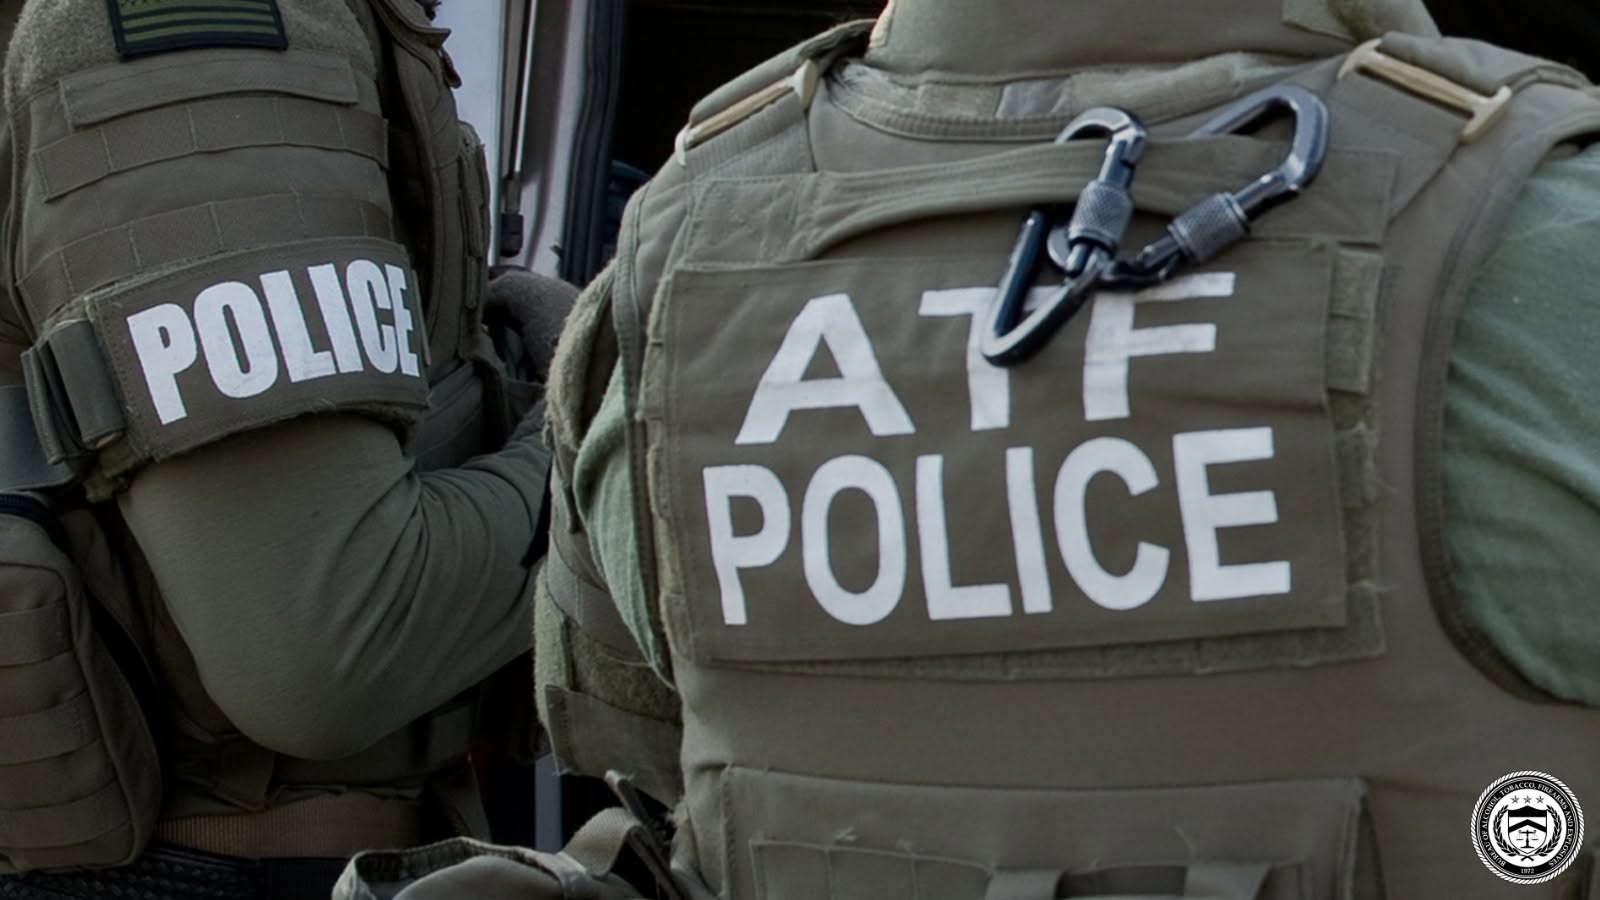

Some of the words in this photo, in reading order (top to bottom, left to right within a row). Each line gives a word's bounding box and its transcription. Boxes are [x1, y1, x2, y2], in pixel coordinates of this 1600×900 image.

[127, 259, 420, 425] POLICE
[735, 272, 1236, 445] ATF
[703, 426, 1291, 626] POLICE
